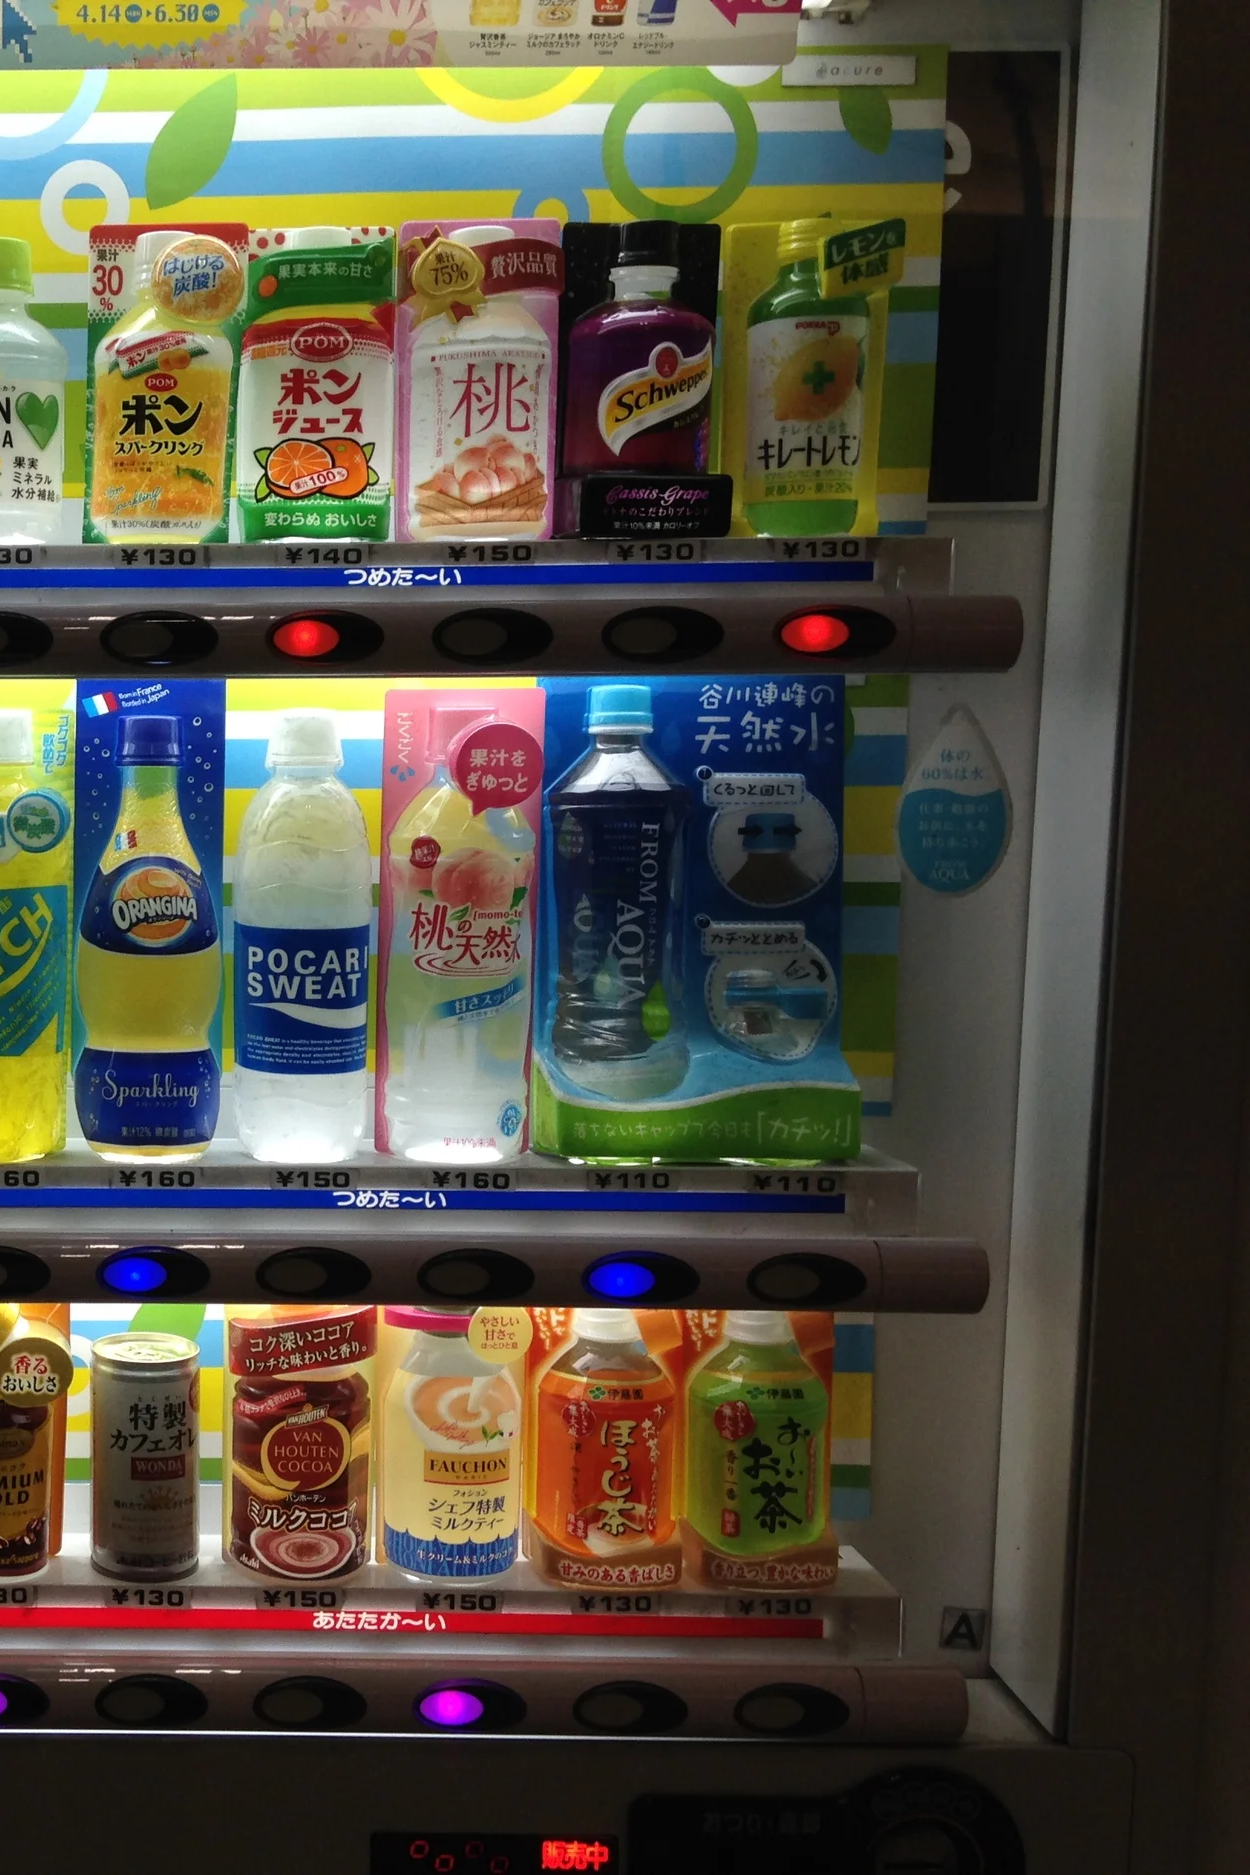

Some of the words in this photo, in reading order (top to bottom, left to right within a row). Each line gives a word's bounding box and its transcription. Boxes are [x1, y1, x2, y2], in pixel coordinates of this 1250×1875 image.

[76, 4, 121, 23] 4.14
[155, 3, 199, 23] 6.30
[277, 261, 375, 281] 果実本来の甘さ
[490, 250, 558, 280] 贅沢品質
[429, 263, 470, 288] 75%
[277, 367, 363, 407] ポン
[449, 362, 532, 438] 桃
[118, 394, 204, 437] ポン
[271, 407, 365, 435] ジュース
[113, 440, 205, 458] スパークリング
[12, 472, 53, 486] ミネラル
[121, 547, 197, 567] ¥130
[284, 547, 363, 565] ¥140
[448, 544, 532, 564] ¥150
[616, 542, 695, 562] ¥130
[782, 539, 860, 559] ¥130
[698, 681, 835, 710] 谷川連峰の
[694, 710, 835, 754] 天然水
[469, 748, 527, 768] 果汁を
[466, 772, 529, 794] ぎゅっと
[713, 783, 796, 797] くるっと回して
[638, 821, 661, 903] FROM
[111, 895, 198, 932] ORANGINA
[246, 944, 369, 976] POCARI
[607, 899, 647, 1008] AQUA
[246, 971, 362, 1000] SWEAT
[100, 1068, 200, 1108] Sparkling
[118, 1169, 195, 1188] ¥160
[275, 1170, 351, 1188] ¥150
[432, 1170, 511, 1190] ¥160
[594, 1171, 670, 1190] ¥110
[752, 1173, 836, 1194] ¥110
[479, 1316, 520, 1328] やさしい
[249, 1320, 355, 1354] コク深いココア
[245, 1342, 368, 1374] リッチな味わいと香り。
[128, 1401, 187, 1432] 特製
[293, 1431, 323, 1444] VAN
[273, 1445, 340, 1459] HOUTEN
[277, 1460, 334, 1474] COCOA
[429, 1458, 508, 1476] FAUCHON
[597, 1418, 646, 1537] ほうじ茶
[427, 1496, 506, 1515] シェフ特製
[431, 1517, 504, 1533] ミルクティー
[559, 1562, 676, 1584] 甘みのある香ばしさ
[711, 1562, 835, 1585] 香り立つ、豊かな味わい
[111, 1587, 184, 1607] ¥130
[262, 1589, 337, 1608] ¥150
[422, 1592, 498, 1612] ¥150
[578, 1595, 652, 1612] ¥130
[737, 1598, 812, 1615] ¥130
[541, 1840, 610, 1870] 販売中
